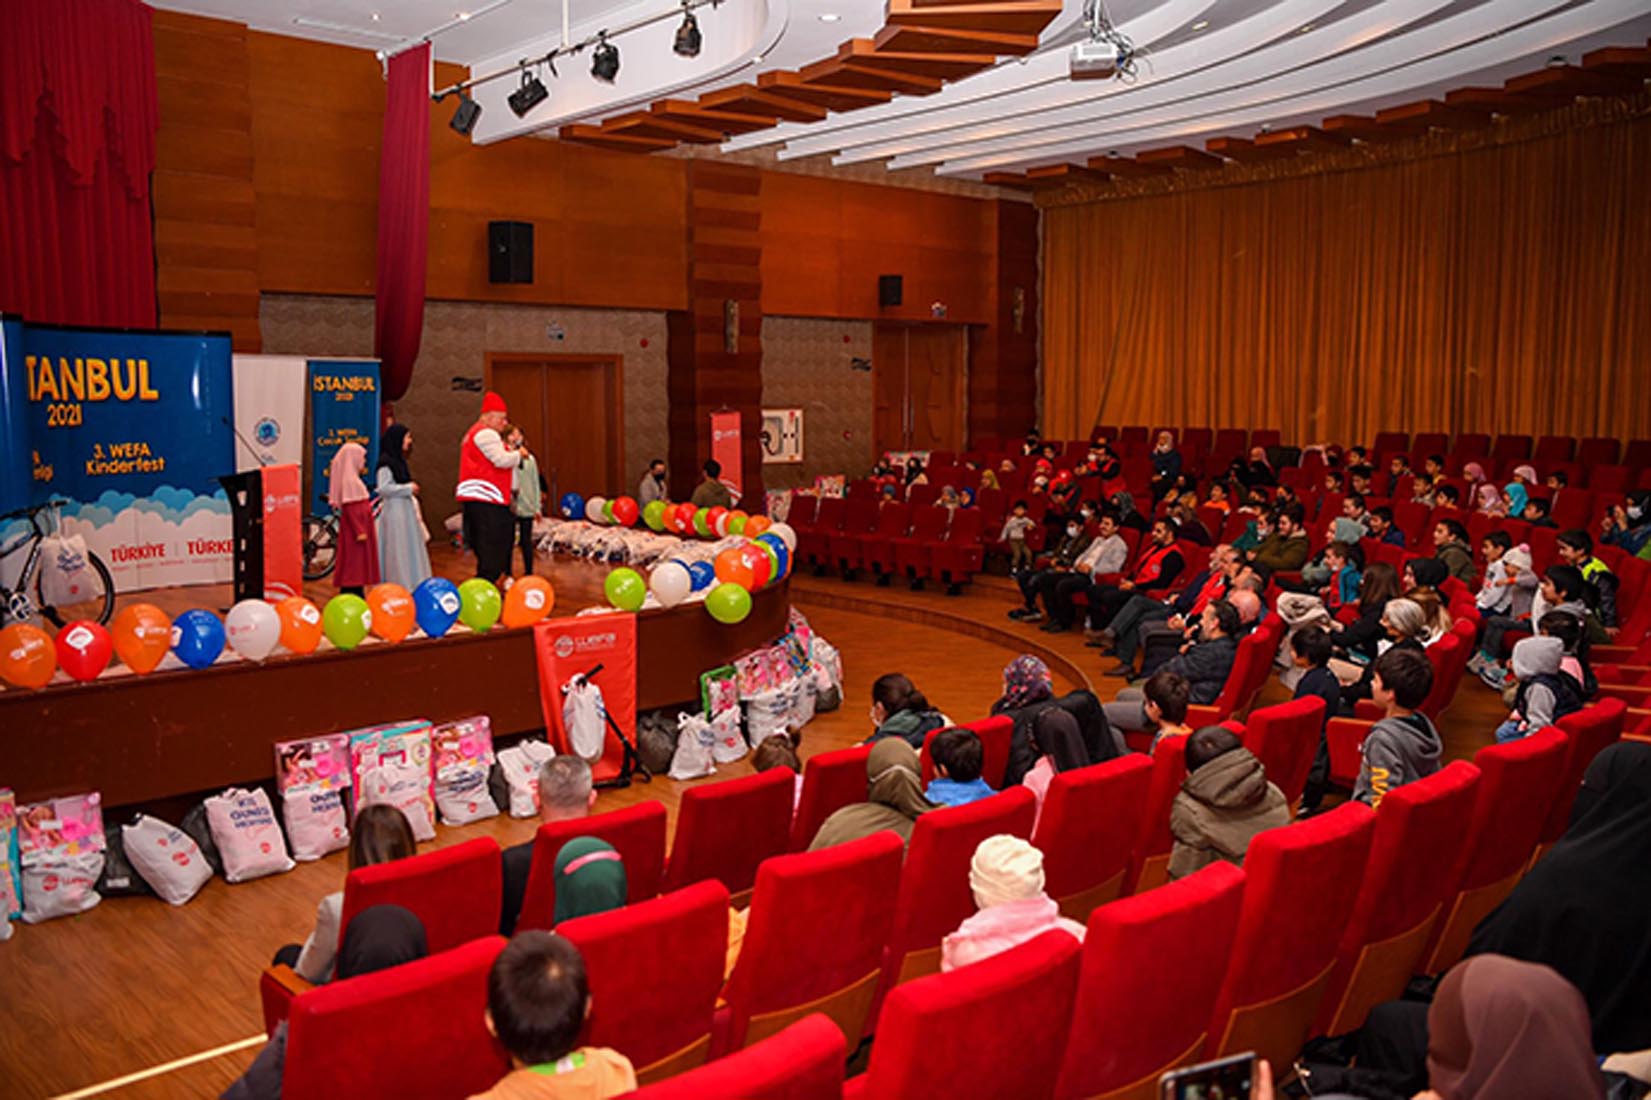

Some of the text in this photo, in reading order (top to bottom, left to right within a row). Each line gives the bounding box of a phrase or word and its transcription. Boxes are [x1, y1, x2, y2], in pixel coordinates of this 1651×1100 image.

[47, 403, 83, 427] 2021
[109, 442, 151, 458] WEFA
[86, 457, 165, 476] Kinderfest
